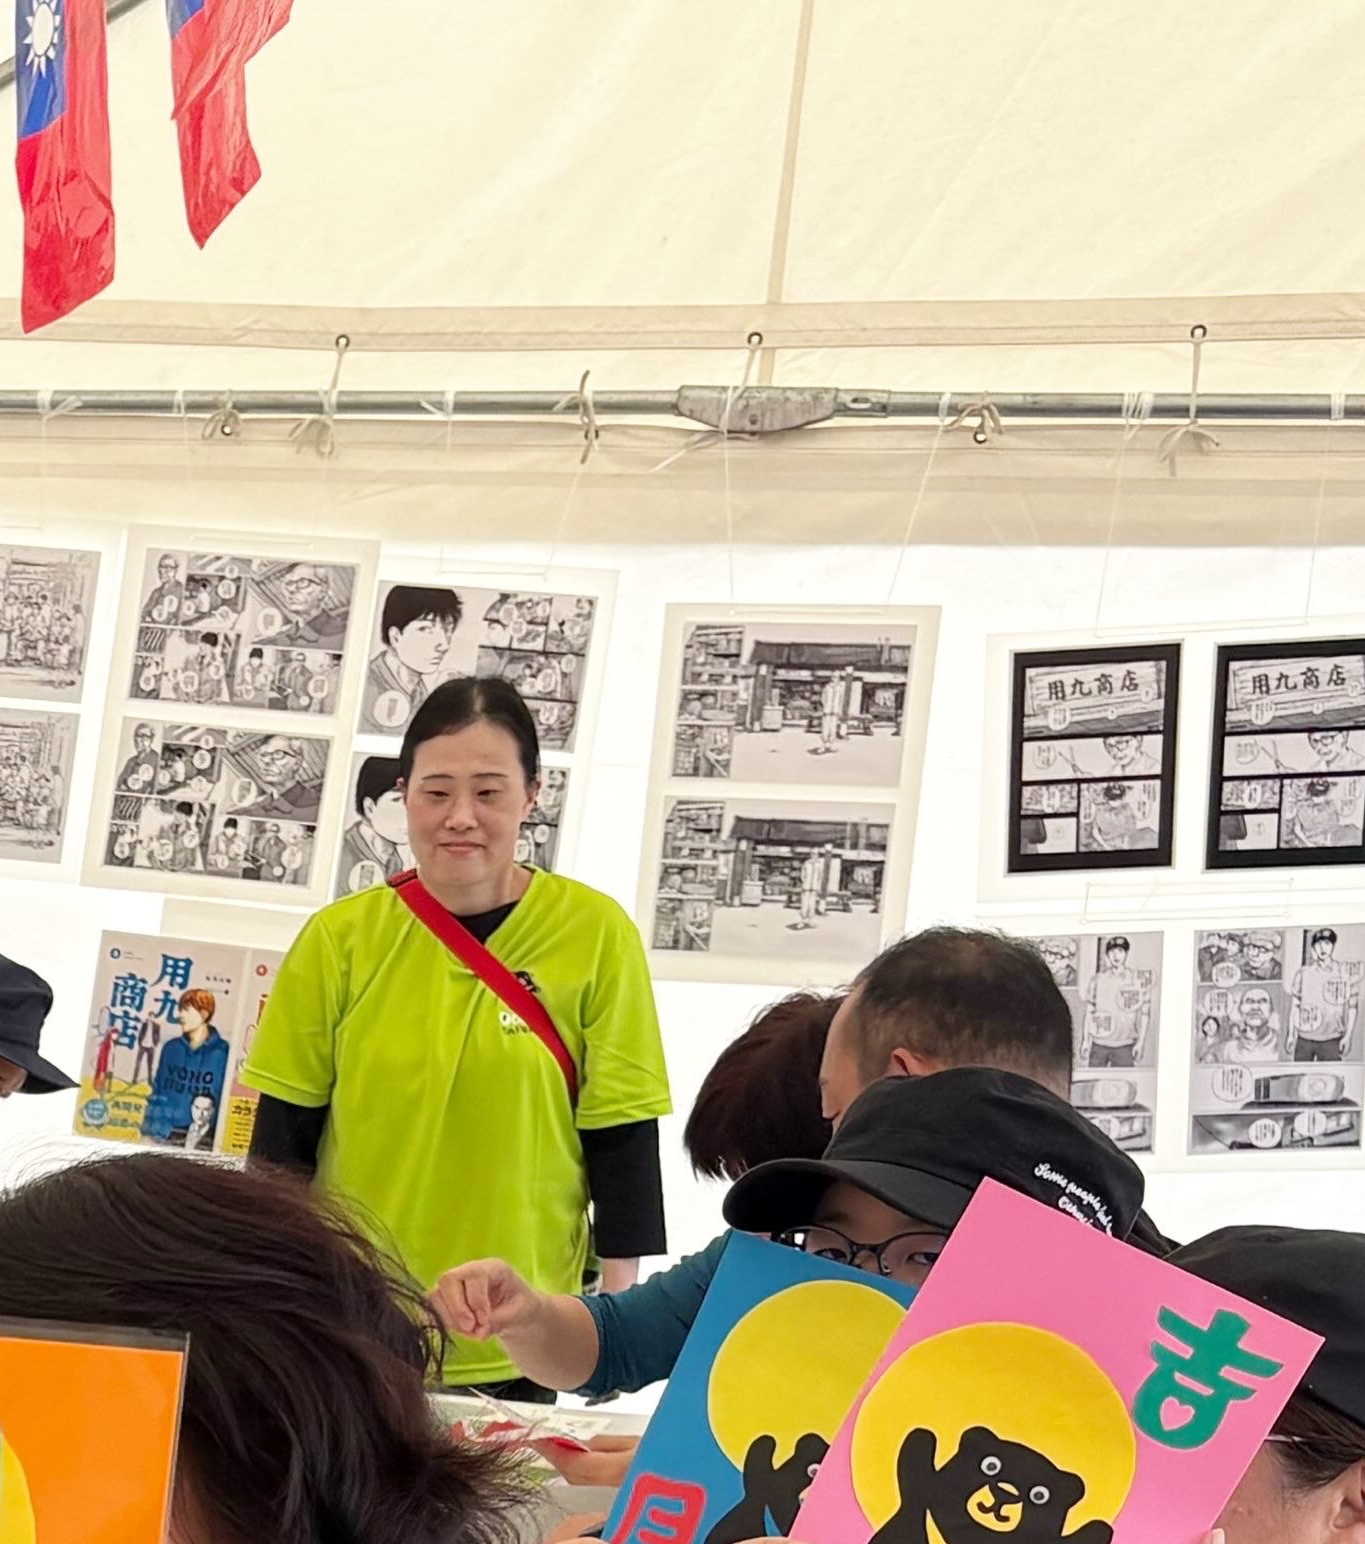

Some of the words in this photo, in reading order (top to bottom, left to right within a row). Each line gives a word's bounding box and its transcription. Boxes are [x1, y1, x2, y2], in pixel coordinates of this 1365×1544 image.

[1046, 669, 1141, 703] 用九商店
[1251, 663, 1347, 699] 用九商店
[1132, 1304, 1285, 1452] 吉
